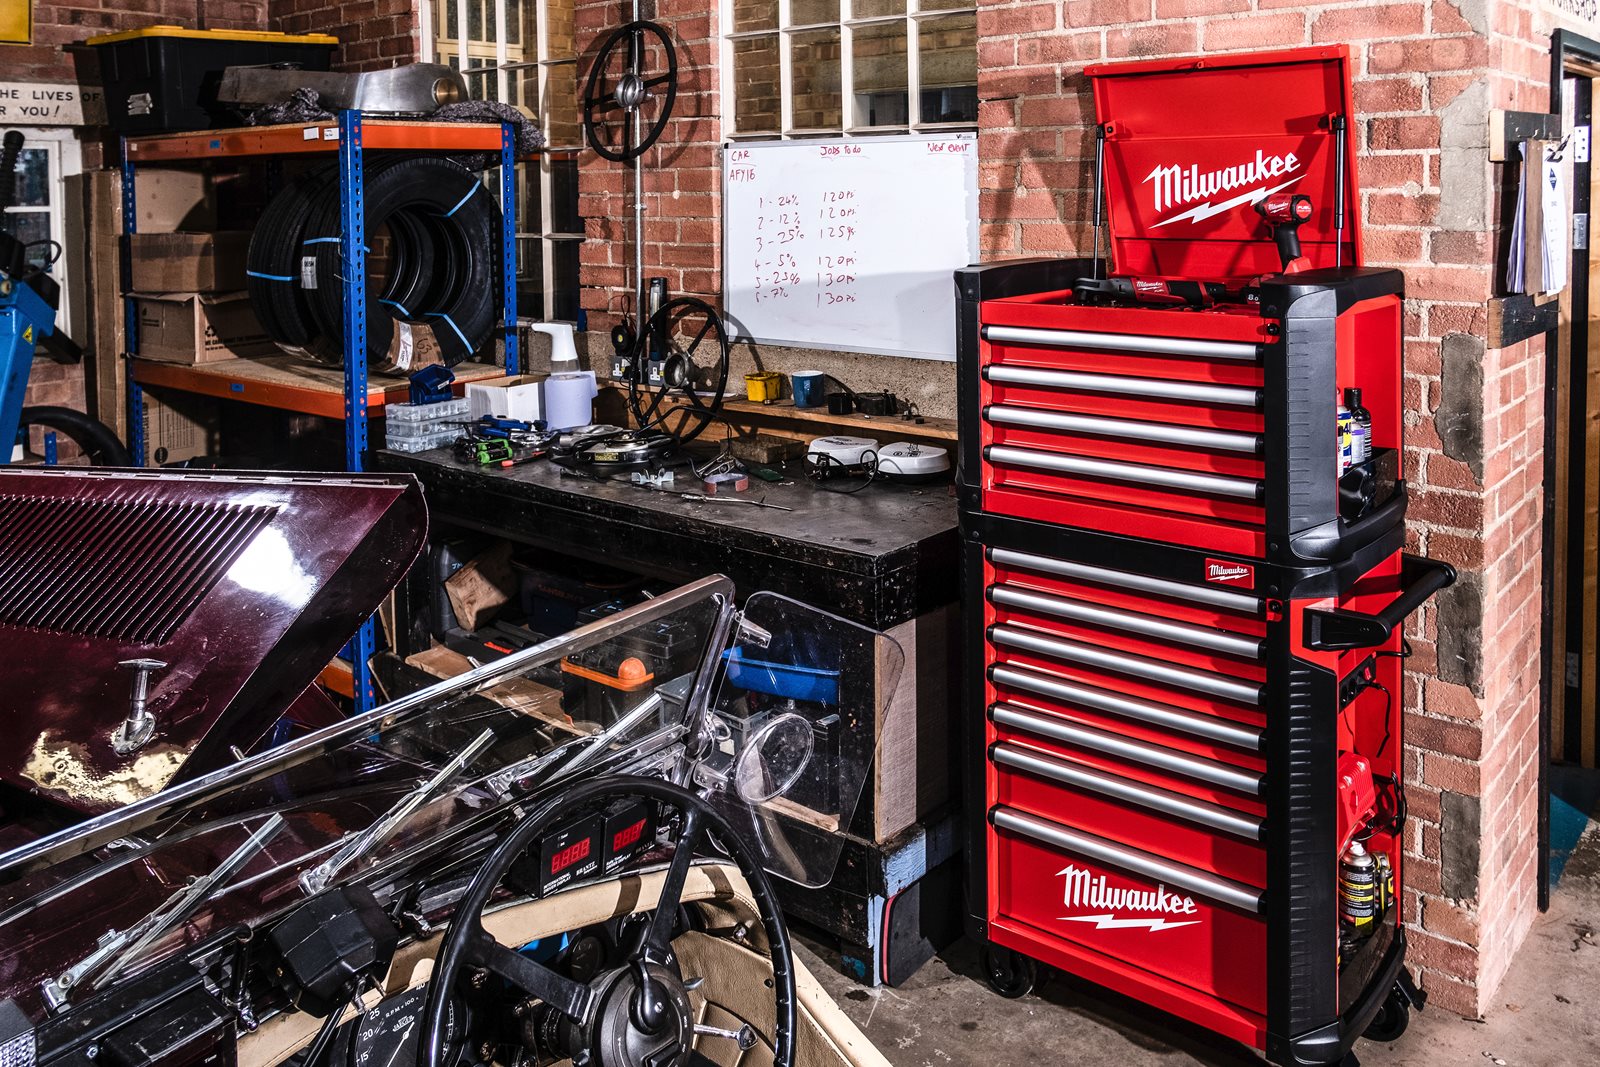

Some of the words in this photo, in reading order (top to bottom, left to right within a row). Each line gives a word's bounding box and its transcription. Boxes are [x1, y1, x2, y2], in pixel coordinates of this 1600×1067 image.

[1549, 0, 1597, 24] KSHOP
[32, 90, 74, 102] LIVES
[81, 92, 101, 102] OF
[19, 104, 60, 118] YOU!
[731, 150, 750, 162] CAR
[1141, 149, 1301, 213] Milwaukee
[1207, 564, 1249, 577] Milwaukee
[1054, 864, 1198, 915] Milwaukee
[369, 1007, 381, 1020] 25
[362, 1028, 374, 1042] 20
[360, 1050, 370, 1063] 15
